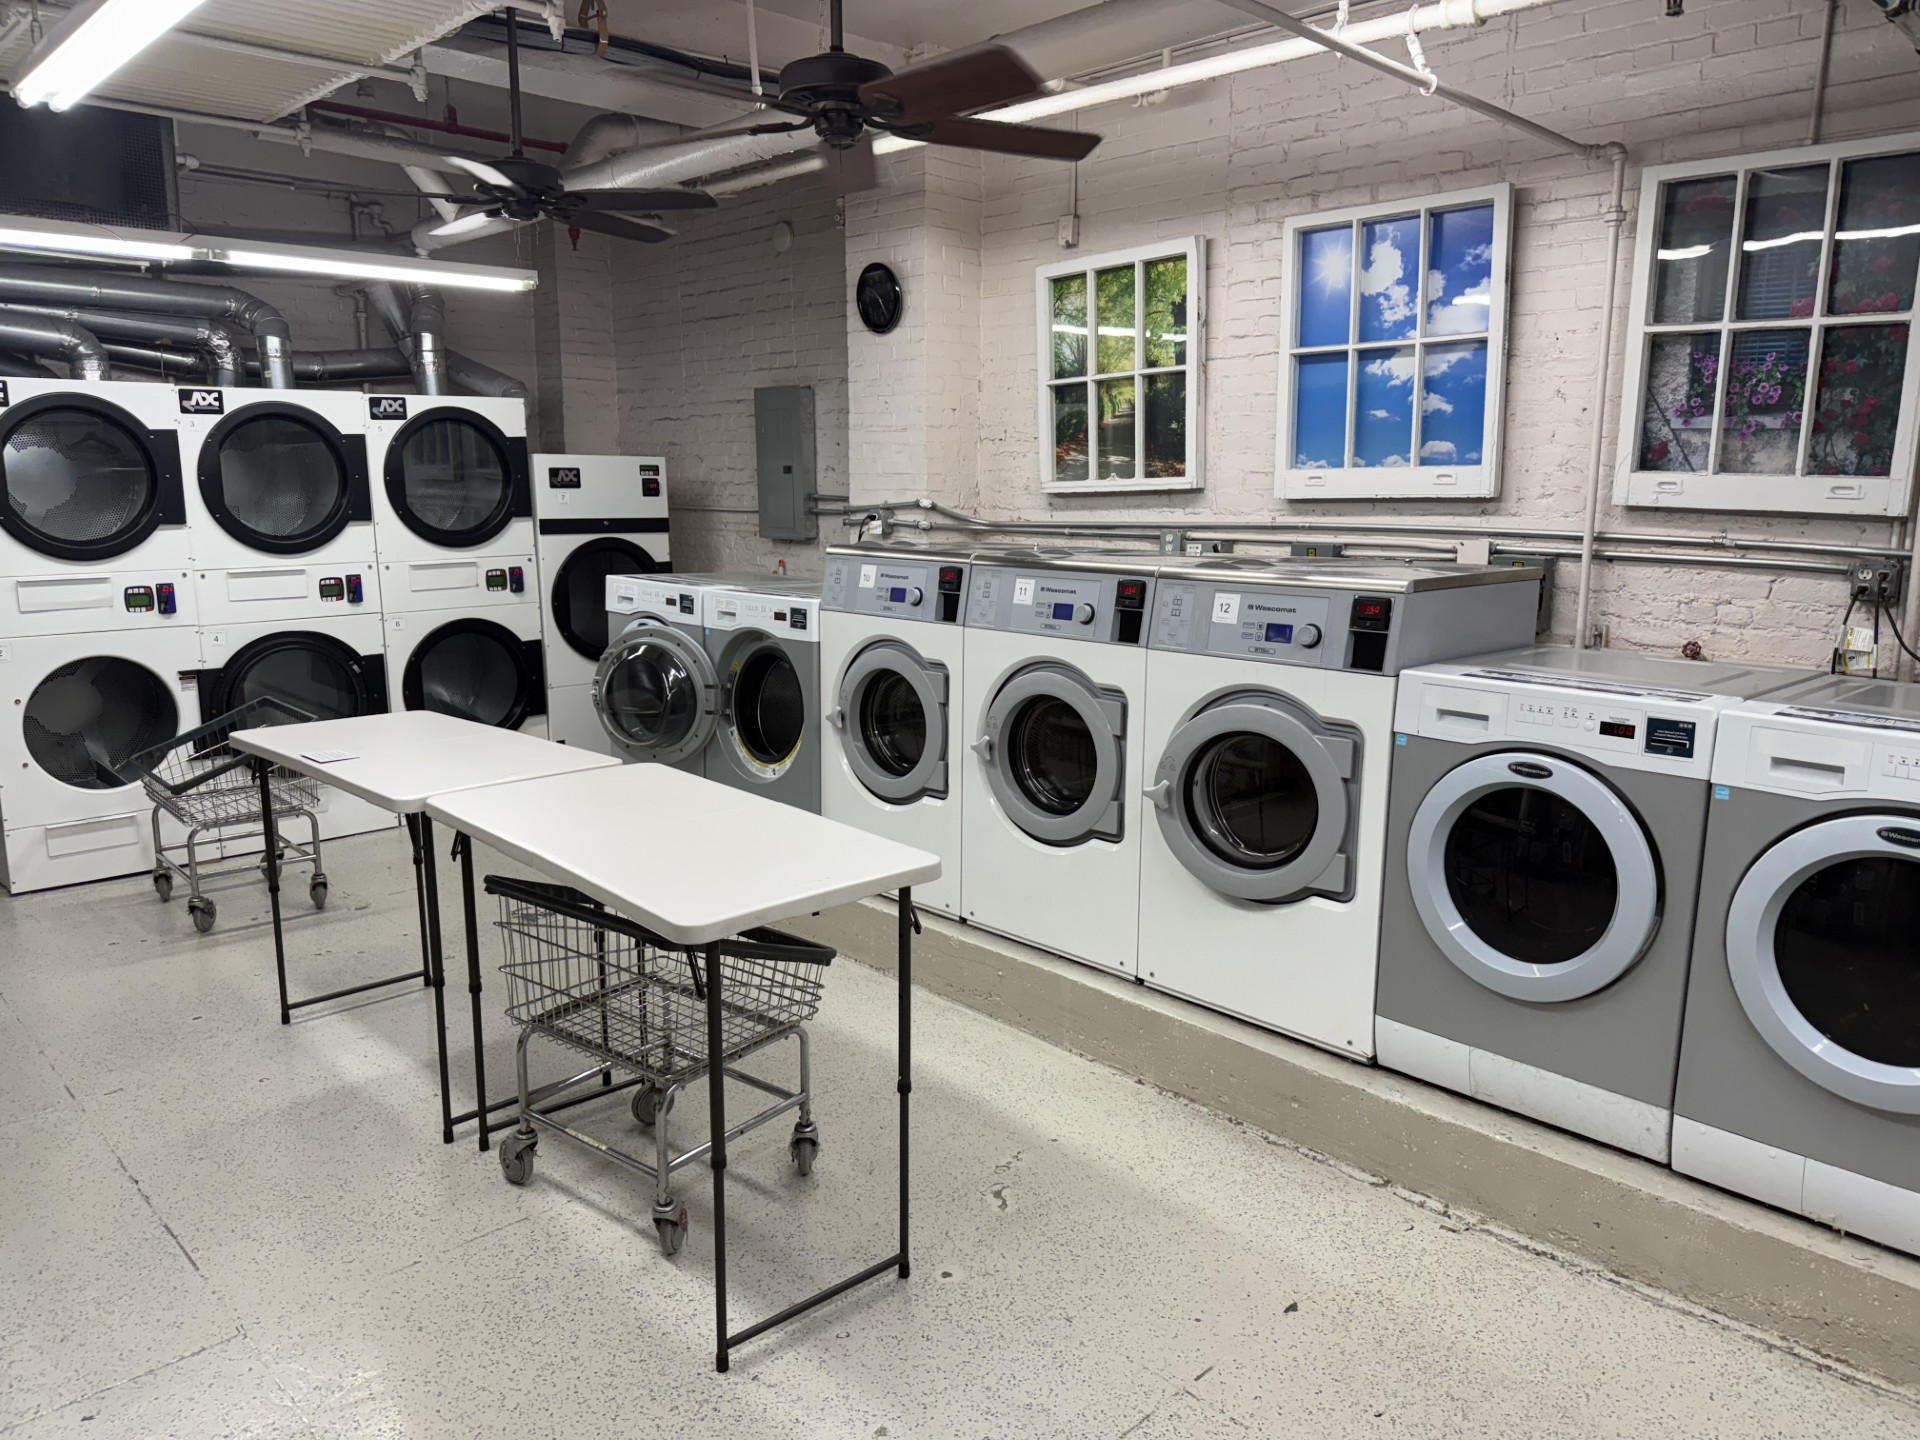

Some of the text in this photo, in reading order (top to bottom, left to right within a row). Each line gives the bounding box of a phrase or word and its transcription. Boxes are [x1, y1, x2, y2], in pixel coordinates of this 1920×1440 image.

[190, 391, 220, 406] ADC
[380, 399, 404, 412] ADC
[557, 469, 578, 482] ADC
[1019, 587, 1028, 596] 11
[1045, 586, 1077, 595] Wascomat
[1219, 602, 1231, 614] 12
[1255, 604, 1297, 613] Wascomat
